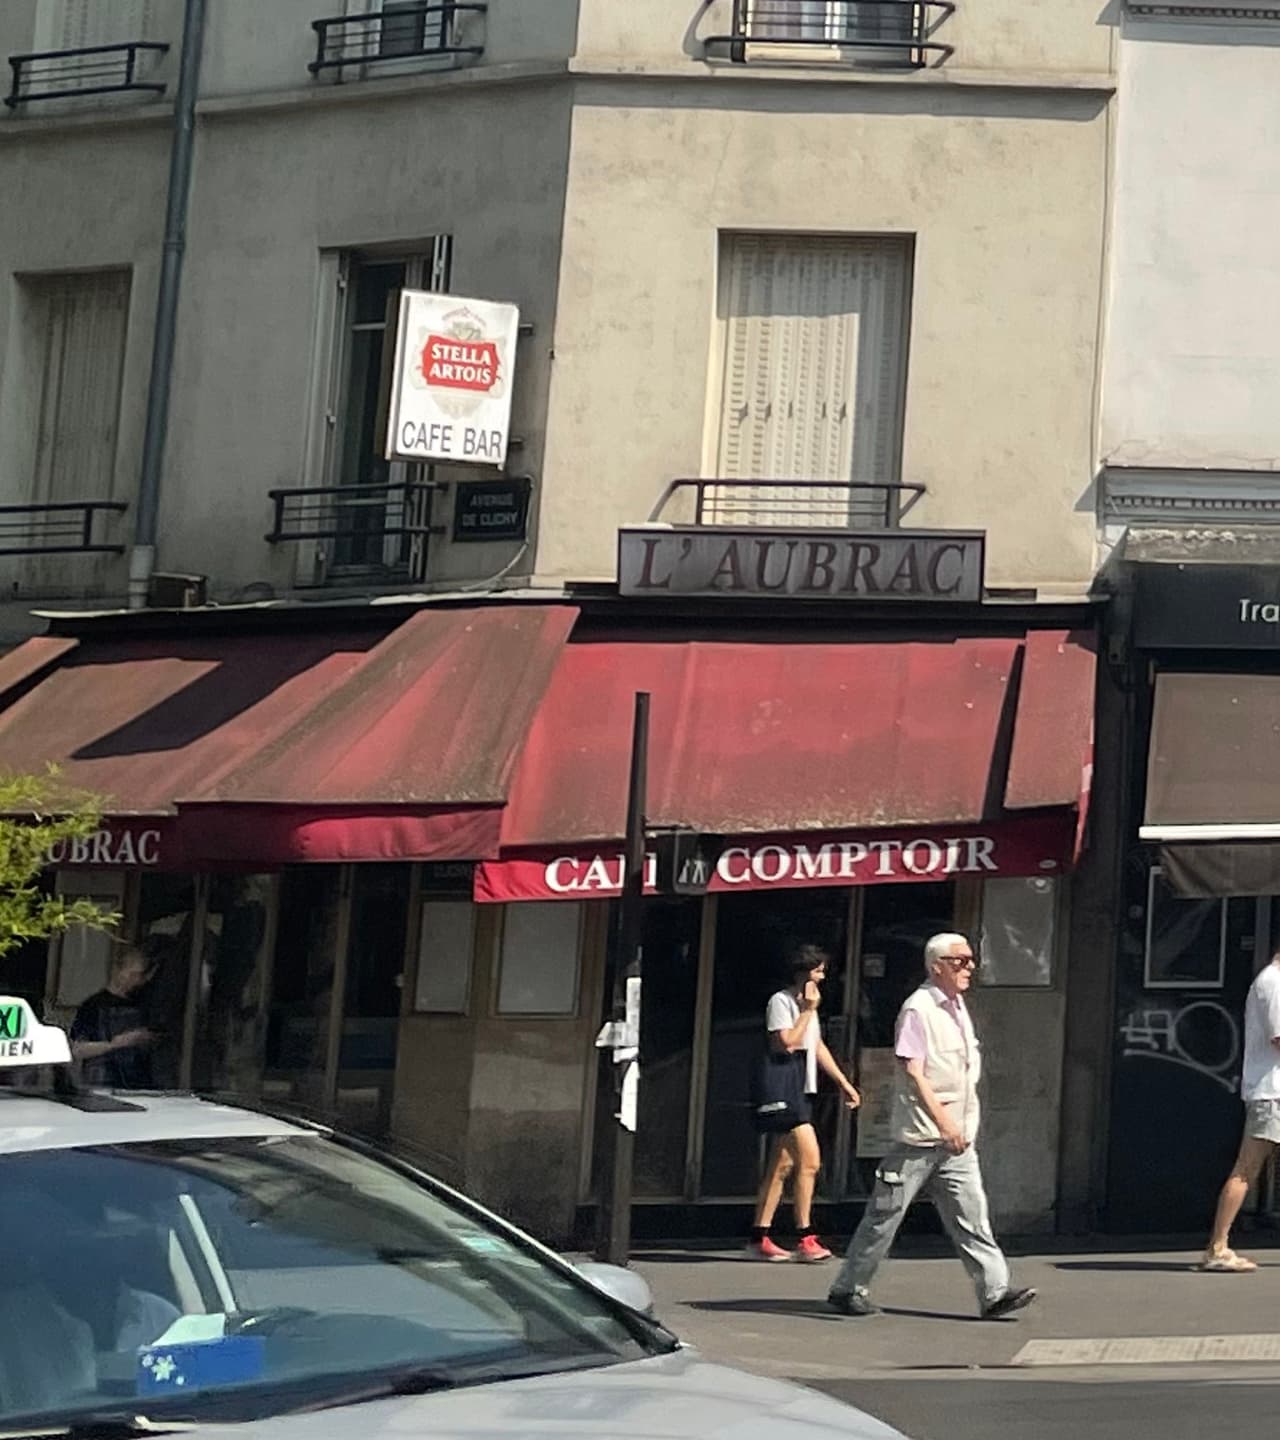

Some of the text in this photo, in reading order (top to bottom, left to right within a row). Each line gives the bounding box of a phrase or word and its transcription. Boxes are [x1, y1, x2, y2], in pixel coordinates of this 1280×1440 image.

[431, 343, 491, 366] STELLA
[429, 364, 492, 384] ARTOIS
[402, 421, 502, 458] CAFE BAR
[41, 828, 161, 865] UBRAC
[716, 836, 999, 884] COMPTOIR
